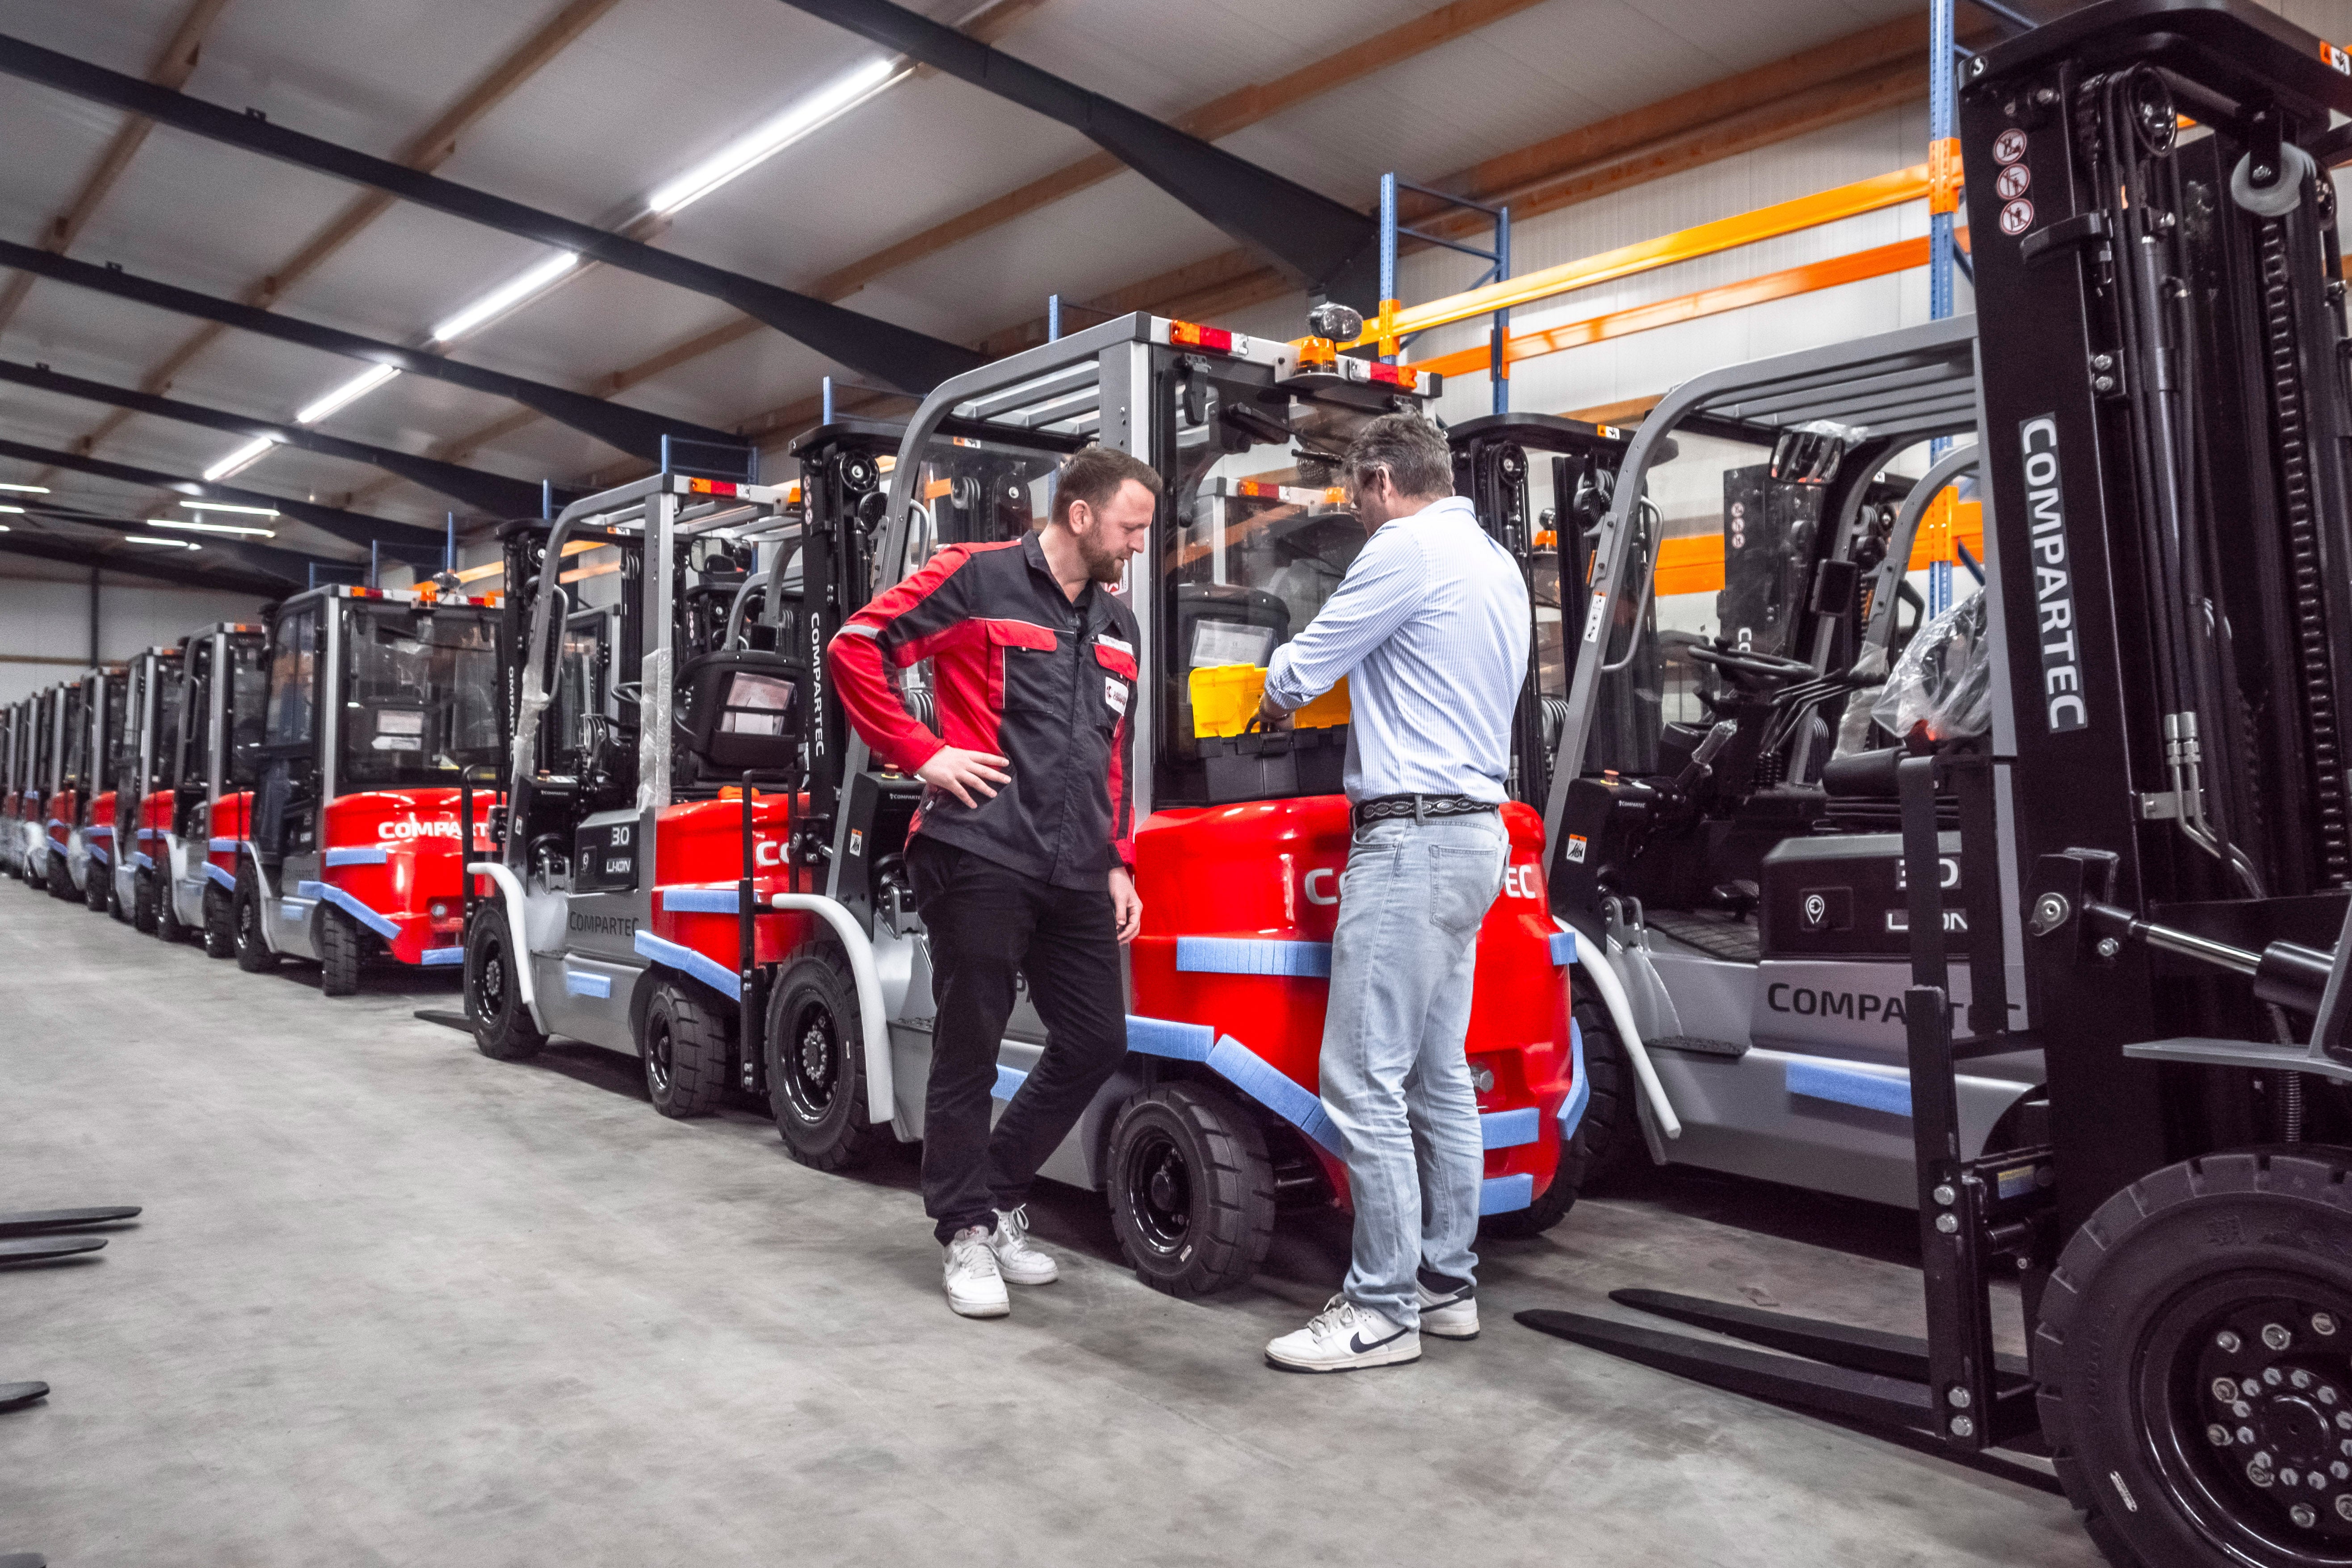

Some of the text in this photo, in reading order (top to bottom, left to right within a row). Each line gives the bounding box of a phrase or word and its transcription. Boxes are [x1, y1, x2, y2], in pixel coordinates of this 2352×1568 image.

[2023, 418, 2085, 729] COMPARTEC
[811, 612, 824, 757] COMPARTEC
[378, 821, 489, 838] COMPAT
[612, 826, 630, 845] 30
